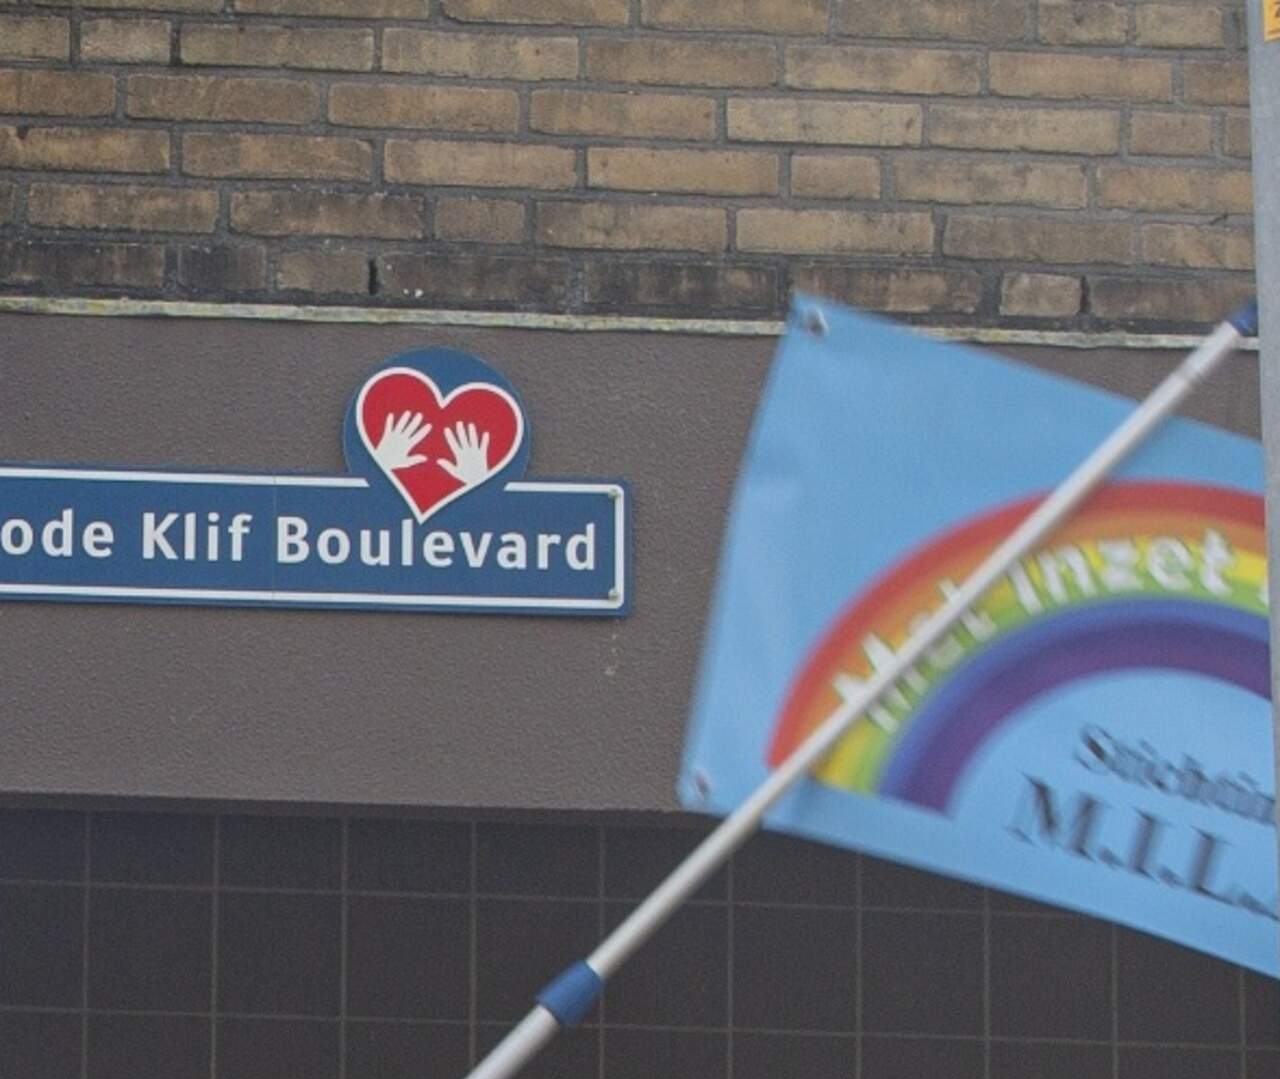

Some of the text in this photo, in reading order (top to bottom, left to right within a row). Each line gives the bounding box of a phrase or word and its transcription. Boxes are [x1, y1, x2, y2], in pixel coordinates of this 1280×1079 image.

[142, 511, 253, 562] Klif
[276, 516, 597, 571] Boulevard
[1006, 527, 1242, 617] Inzet
[1004, 770, 1280, 922] M.I.L.
